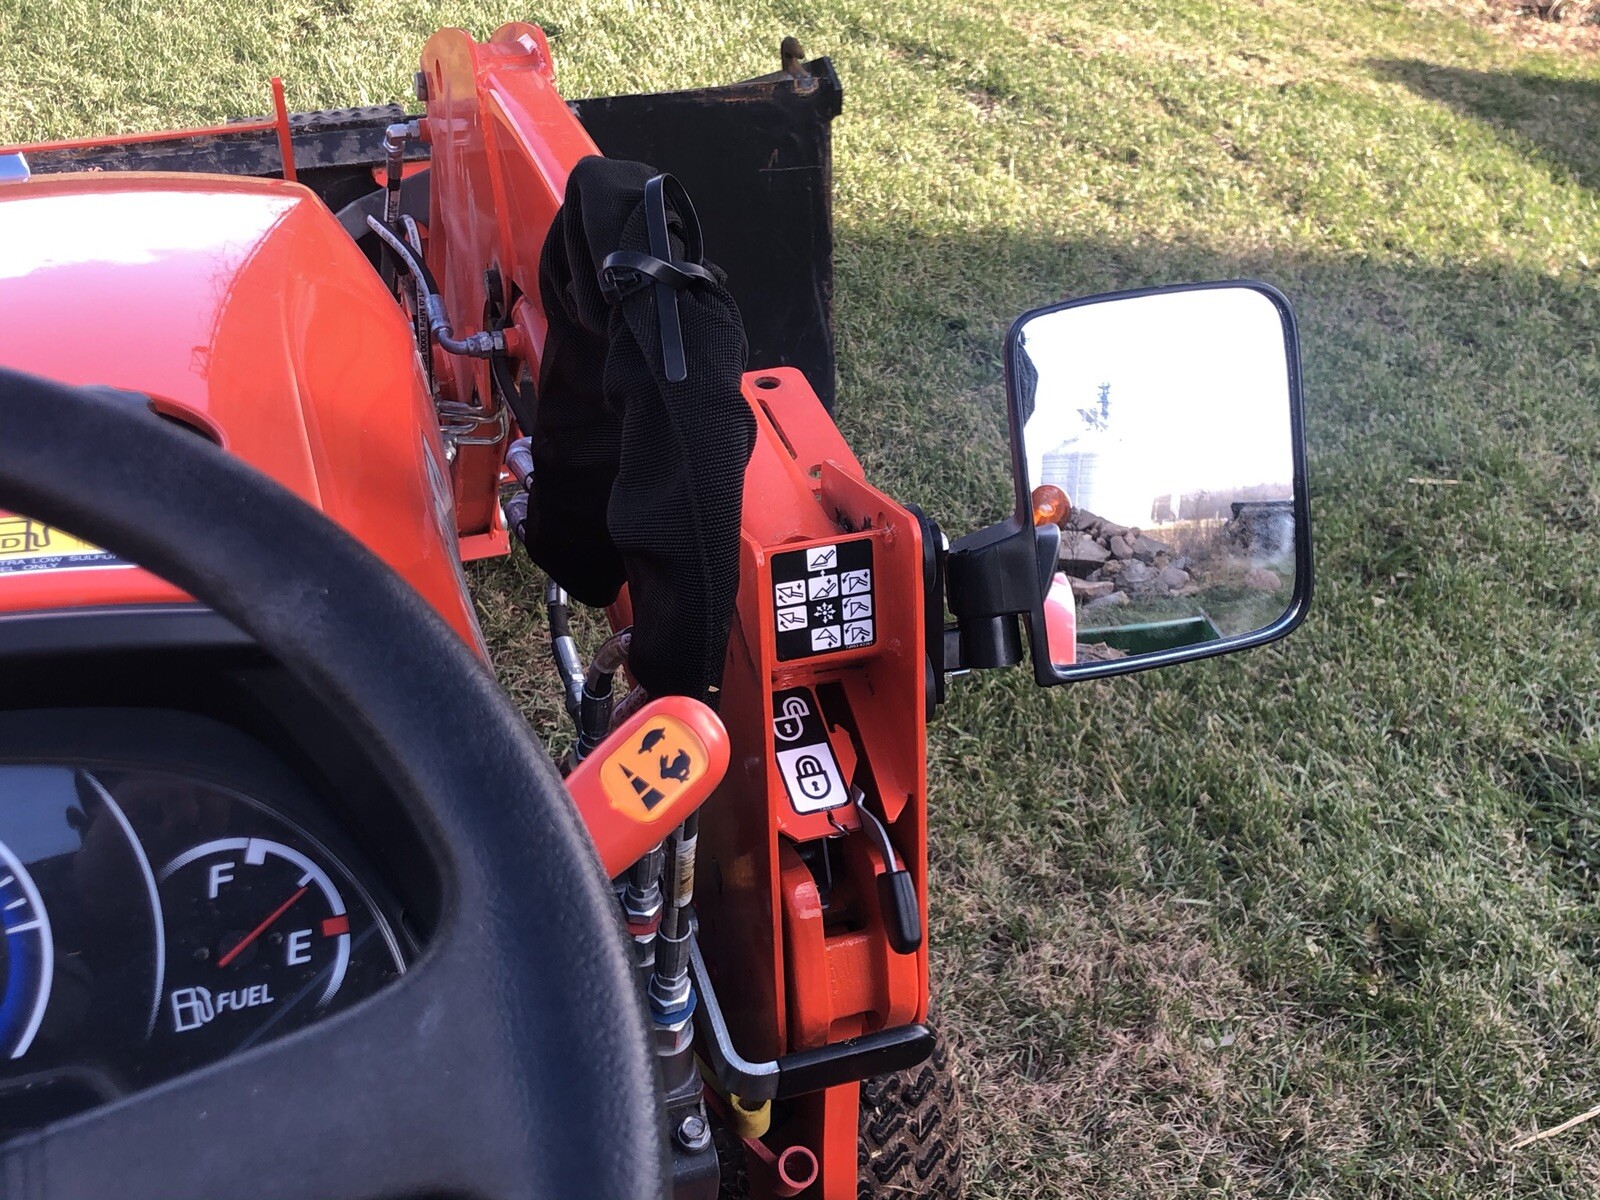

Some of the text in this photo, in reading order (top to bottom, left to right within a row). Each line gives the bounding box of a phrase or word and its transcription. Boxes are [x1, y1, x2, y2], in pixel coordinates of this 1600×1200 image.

[418, 308, 427, 329] MPa
[209, 862, 236, 898] F
[288, 929, 313, 966] E
[216, 983, 275, 1014] FUEL
